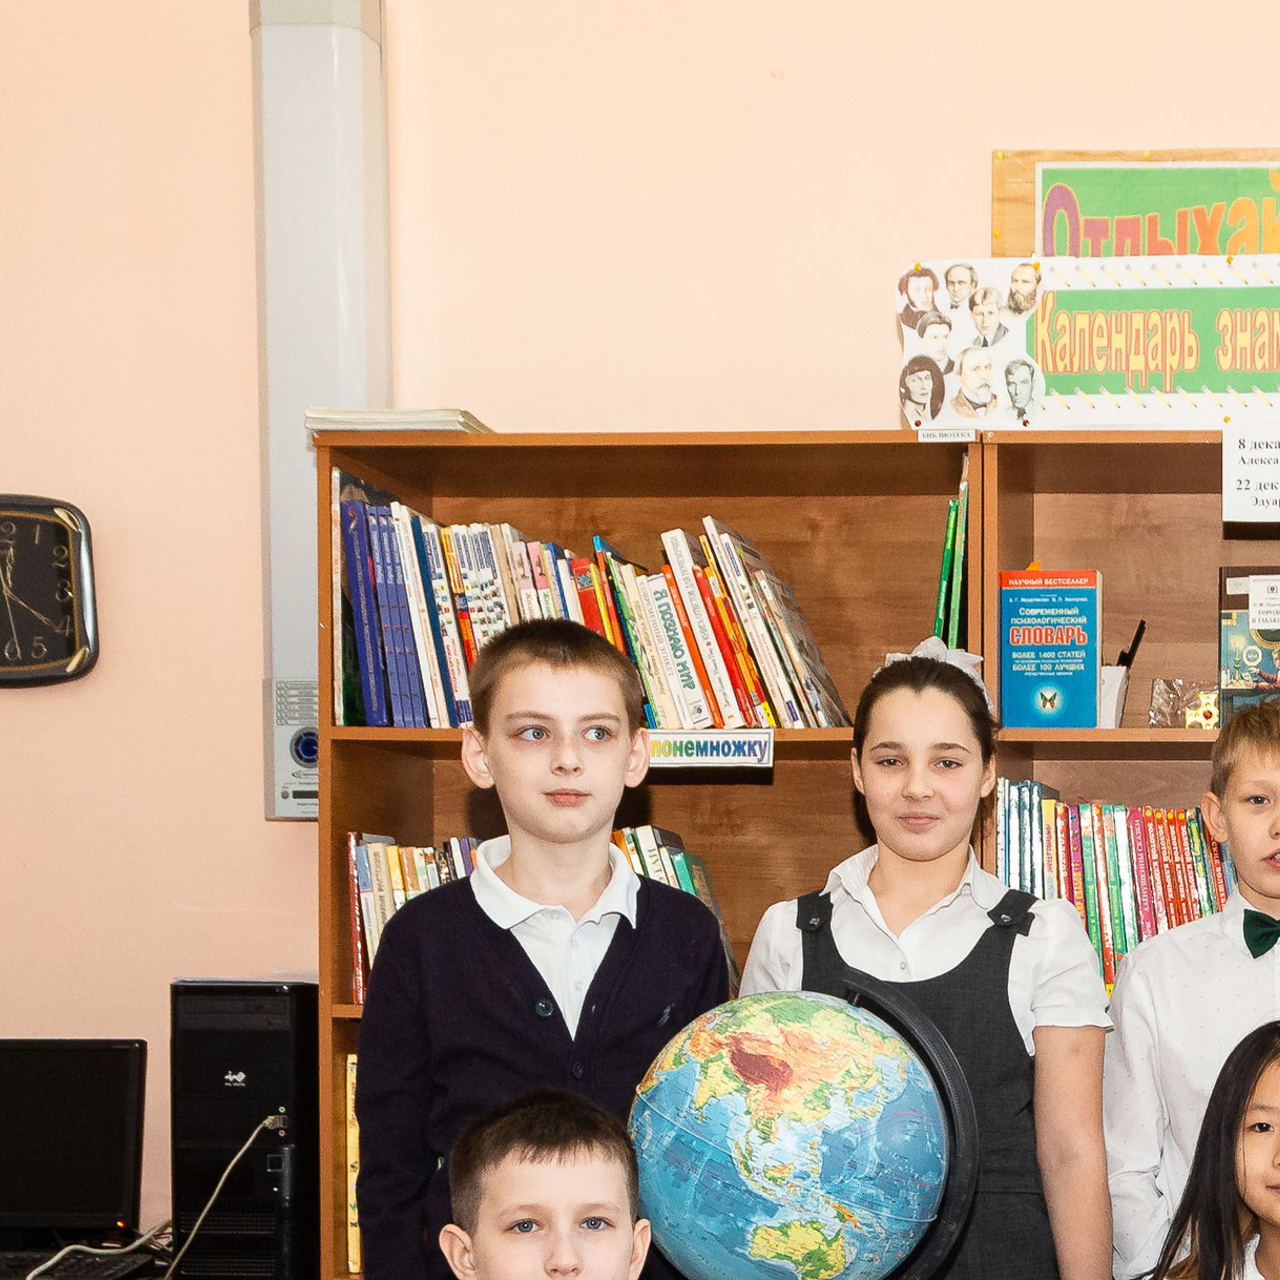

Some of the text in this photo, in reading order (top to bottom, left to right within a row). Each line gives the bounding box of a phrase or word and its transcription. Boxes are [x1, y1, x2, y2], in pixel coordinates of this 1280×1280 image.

[1034, 290, 1201, 394] Календарь
[1238, 438, 1245, 449] 8
[1236, 479, 1250, 490] 22
[1011, 615, 1087, 625] ПСИХОЛОГИЧЕСКИЙ
[31, 636, 47, 659] 5
[653, 588, 696, 690] Я ПОЗНАЮ МИР
[1009, 626, 1088, 645] СЛОВАРЬ
[1057, 650, 1085, 658] СТАТЕЙ
[651, 739, 768, 764] понемножку
[1135, 819, 1144, 851] СКАЗКИ
[1147, 822, 1159, 859] ЗОЛОТОЙ
[1158, 825, 1168, 861] ЗОЛОТОЙ
[1169, 825, 1180, 862] ЗОЛОТОЙ
[1181, 825, 1192, 862] ЗОЛОТОЙ
